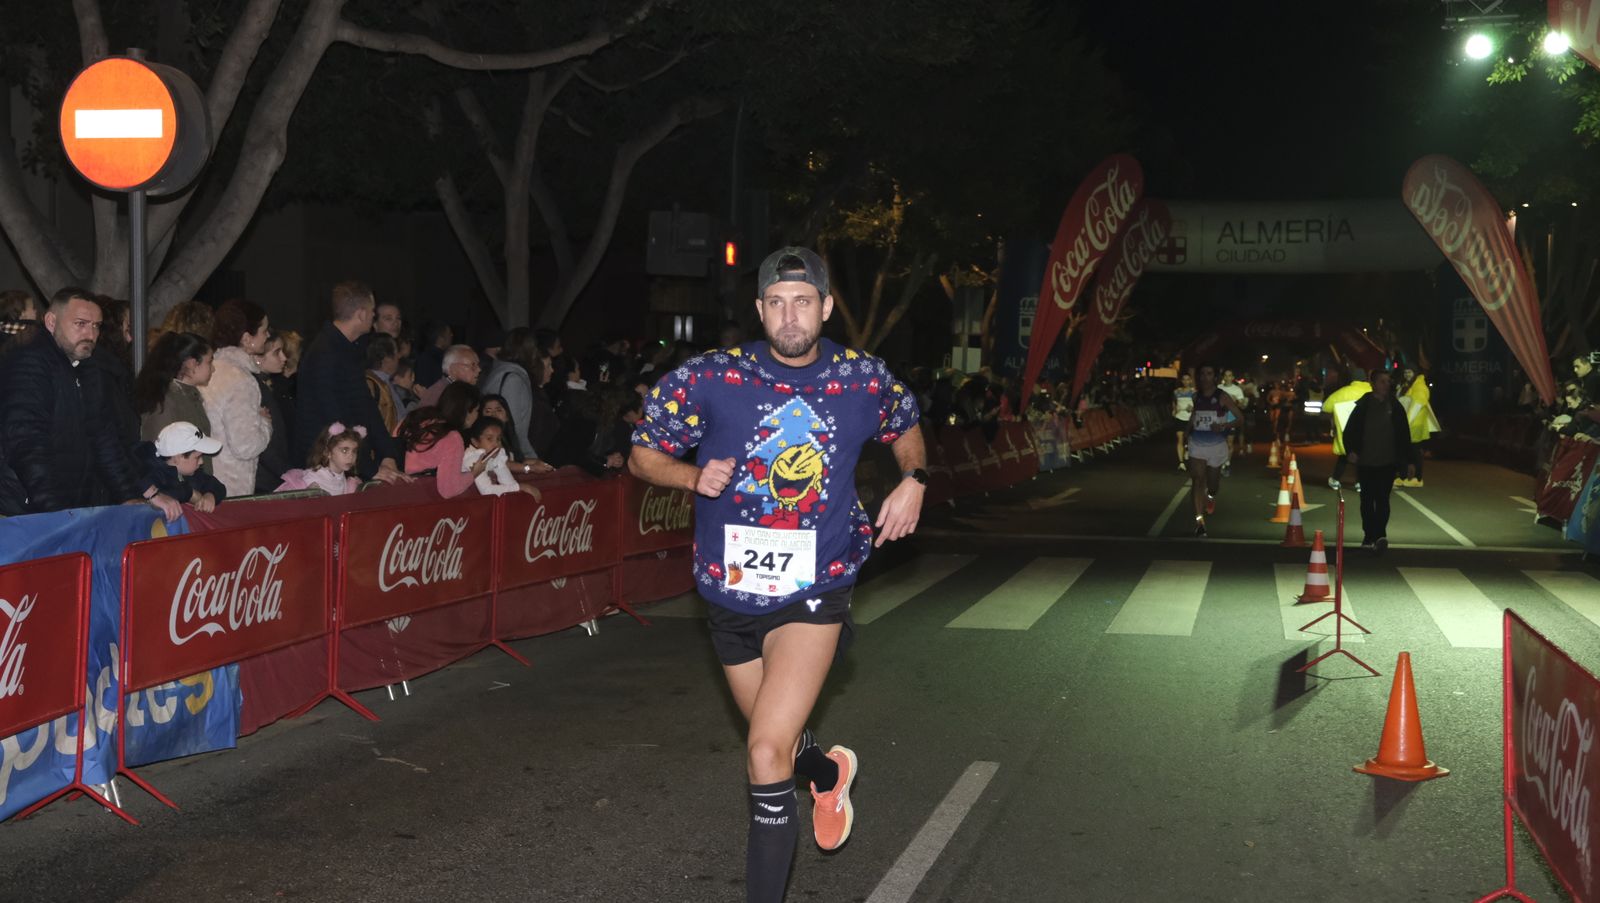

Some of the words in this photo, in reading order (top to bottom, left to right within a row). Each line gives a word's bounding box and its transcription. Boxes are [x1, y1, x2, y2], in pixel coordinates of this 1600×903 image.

[1052, 160, 1136, 310] Coca-Cola
[1216, 248, 1287, 264] CIUDAD
[1217, 214, 1355, 245] ALMERÍA
[378, 516, 470, 592] Coca-Cola
[525, 499, 598, 563] Coca-Cola
[743, 549, 794, 572] 247
[169, 542, 290, 645] Coca-Cola
[1522, 665, 1594, 856] Coca-Cola
